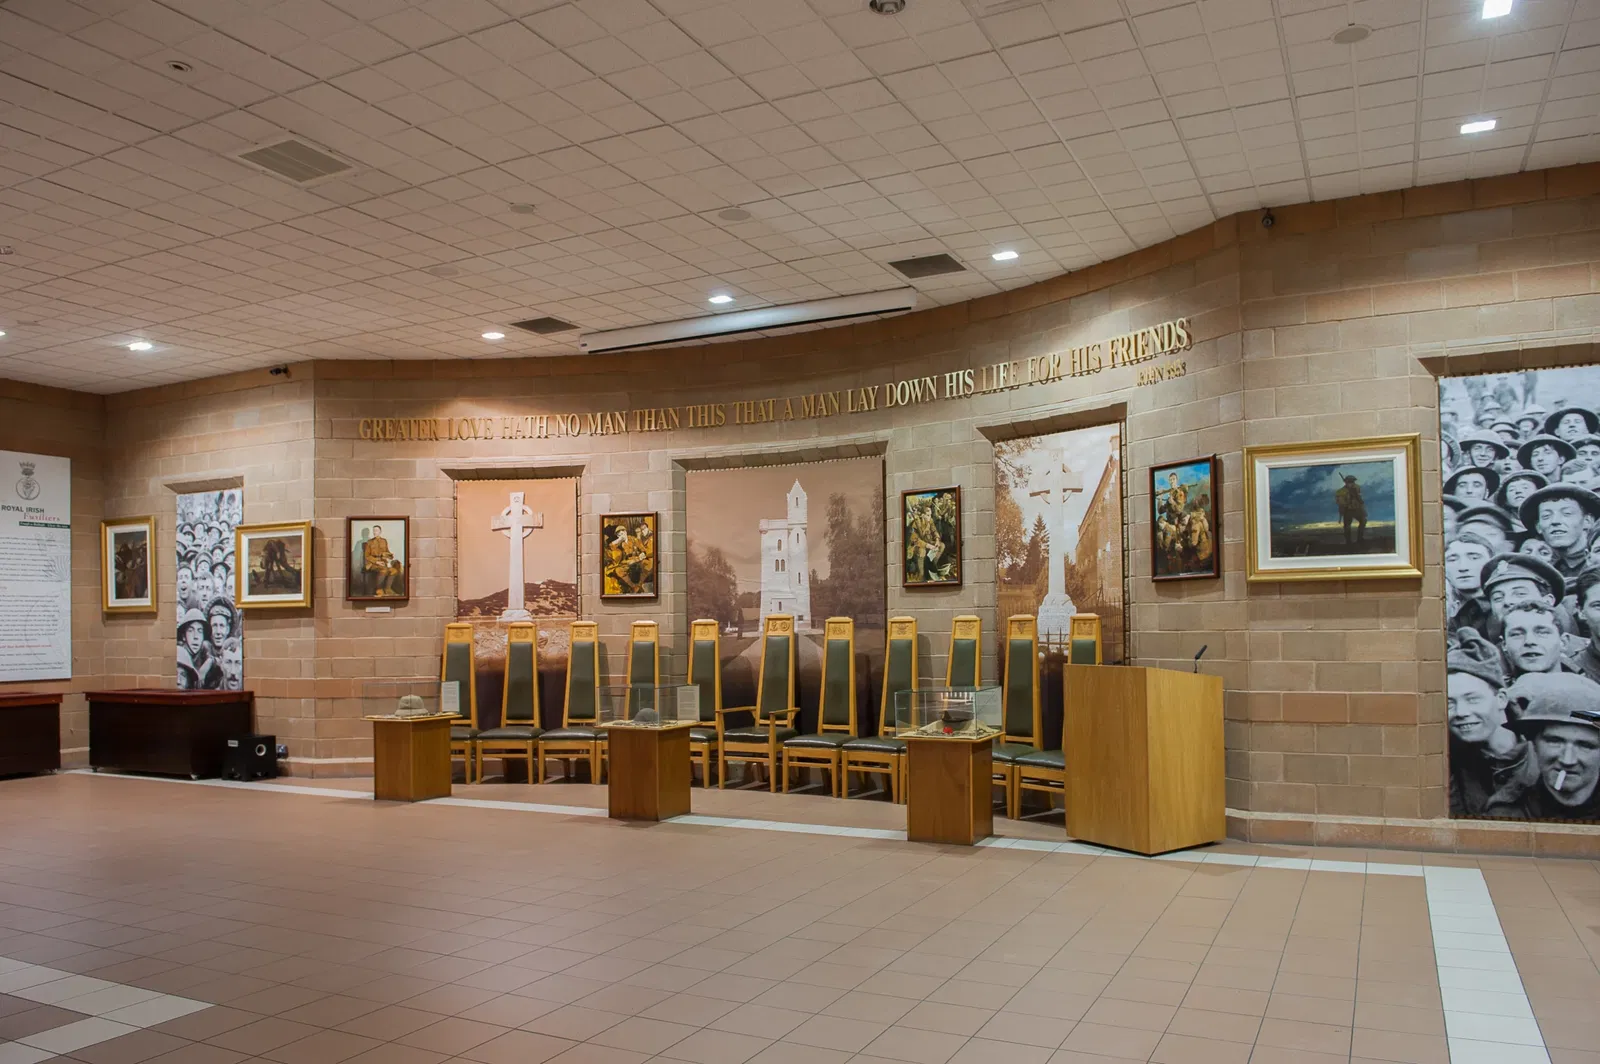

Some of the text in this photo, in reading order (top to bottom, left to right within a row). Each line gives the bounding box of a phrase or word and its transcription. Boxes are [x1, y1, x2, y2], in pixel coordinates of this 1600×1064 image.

[358, 317, 1188, 440] GREATER LOVE HATH NO MAN THAN THIS THAT A MAN LAY DOWN HIS LIFE FOR HIS FRIENDS
